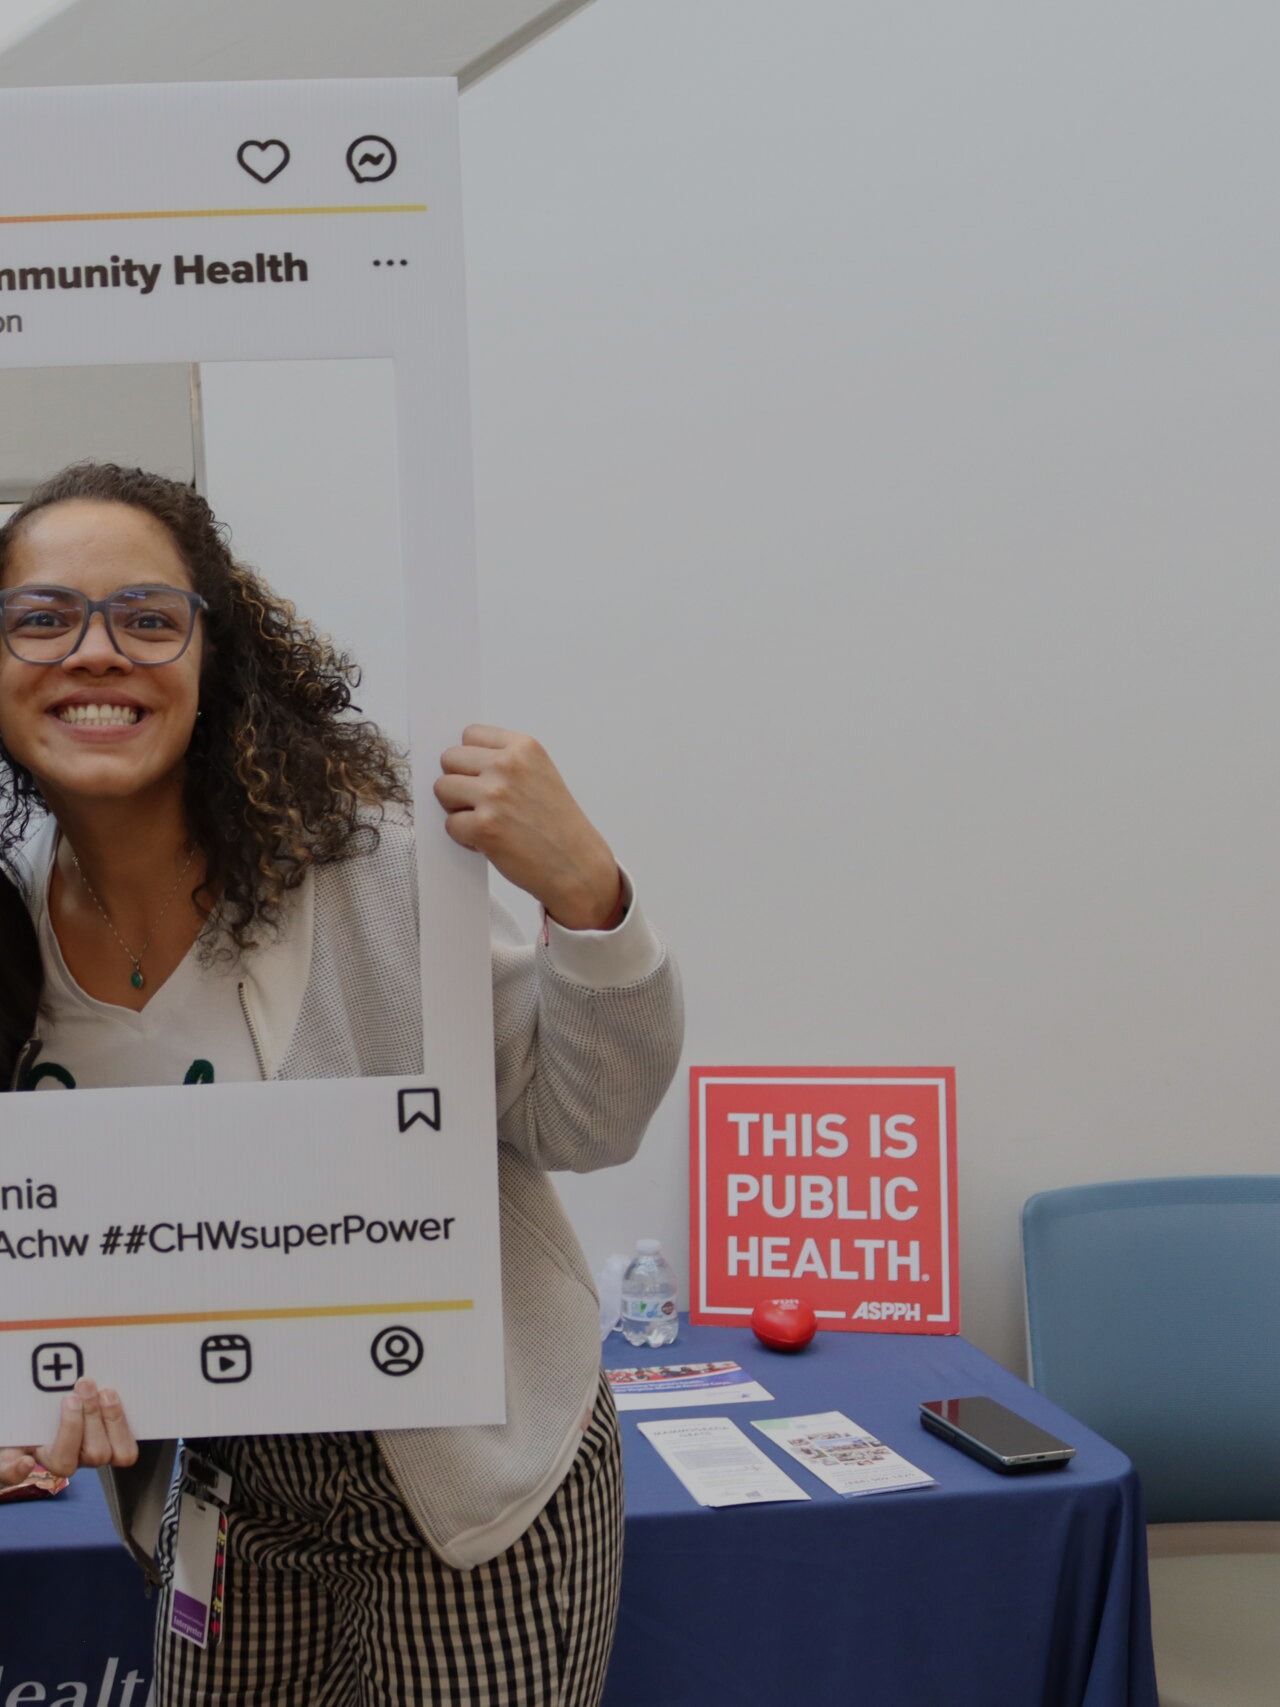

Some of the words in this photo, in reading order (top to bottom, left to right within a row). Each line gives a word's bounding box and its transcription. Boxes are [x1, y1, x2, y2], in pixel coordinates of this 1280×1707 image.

[174, 251, 309, 286] Health
[727, 1113, 849, 1158] THIS
[869, 1114, 918, 1159] IS
[727, 1173, 919, 1221] PUBLIC
[99, 1212, 456, 1256] ##CHWsuperPower
[727, 1235, 930, 1282] HEALTH.
[852, 1301, 921, 1321] ASPPH
